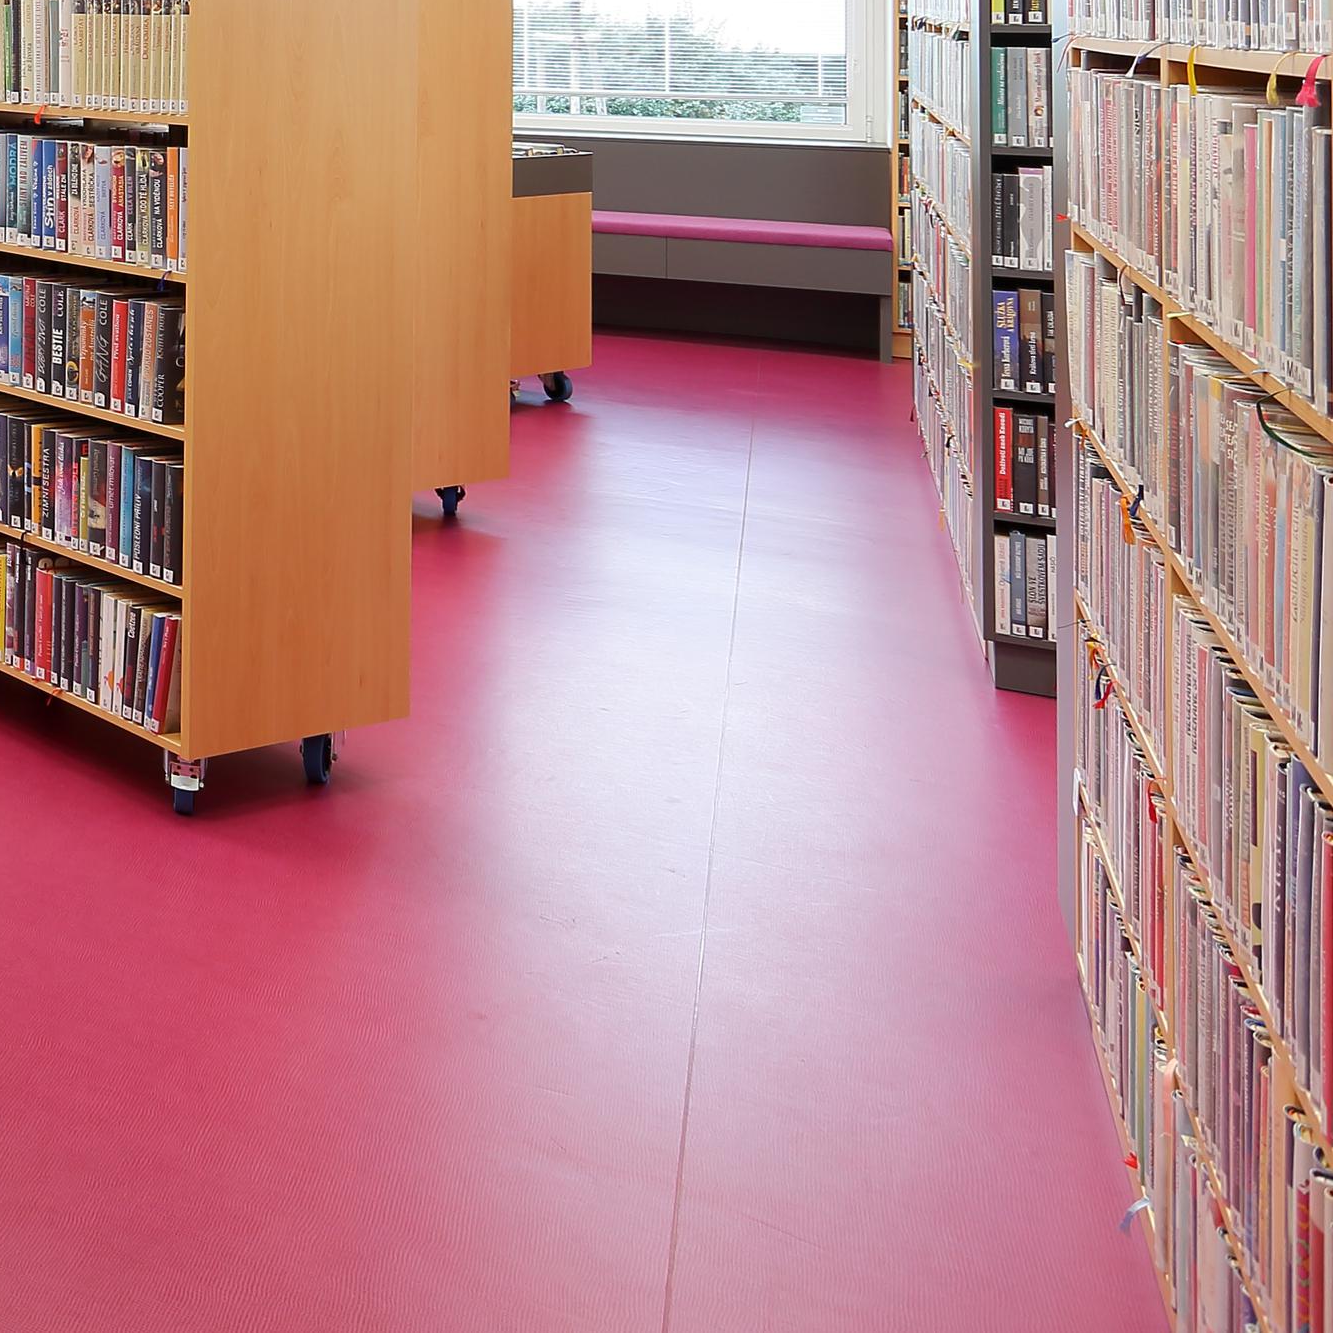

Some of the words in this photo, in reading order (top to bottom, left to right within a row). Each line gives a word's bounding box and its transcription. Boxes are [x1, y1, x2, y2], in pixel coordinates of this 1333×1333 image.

[141, 215, 149, 245] CLARKOVÁ
[37, 288, 46, 313] COLE
[55, 289, 64, 317] COLE
[99, 299, 107, 325] COLE
[52, 329, 63, 365] BESTIE
[96, 334, 109, 383] GANG
[157, 374, 165, 407] COOPER
[41, 448, 50, 487] SESTRA
